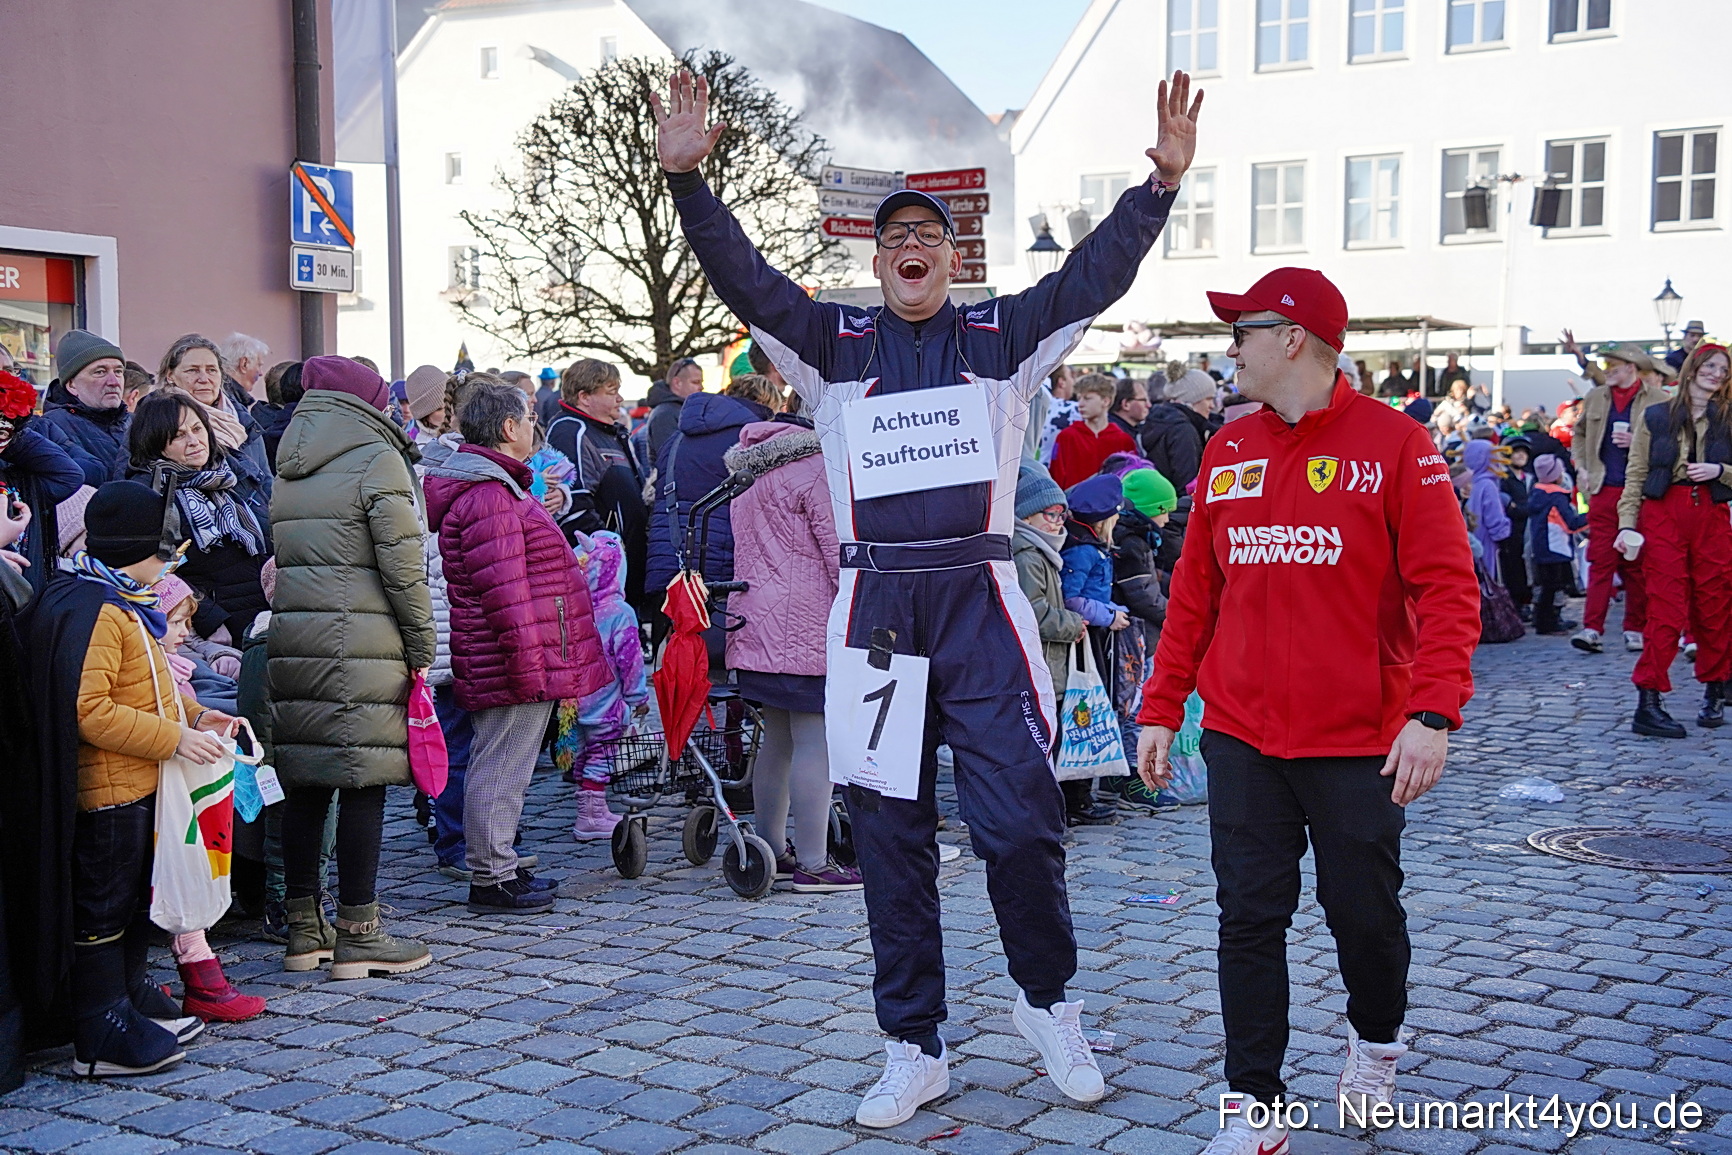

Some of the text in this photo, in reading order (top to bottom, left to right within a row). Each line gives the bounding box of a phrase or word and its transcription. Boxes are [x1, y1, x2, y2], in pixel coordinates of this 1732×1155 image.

[850, 171, 892, 188] Europahalle
[949, 199, 974, 212] Kirche
[317, 263, 348, 278] 30 Min.
[872, 408, 961, 434] Achtung
[861, 437, 980, 469] Sauftourist
[1242, 472, 1261, 488] ups
[1227, 525, 1343, 546] MISSION
[1228, 544, 1343, 566] WINNOW
[1020, 690, 1033, 716] HS-3
[862, 679, 899, 751] 1
[851, 773, 888, 786] Faschingsumzug
